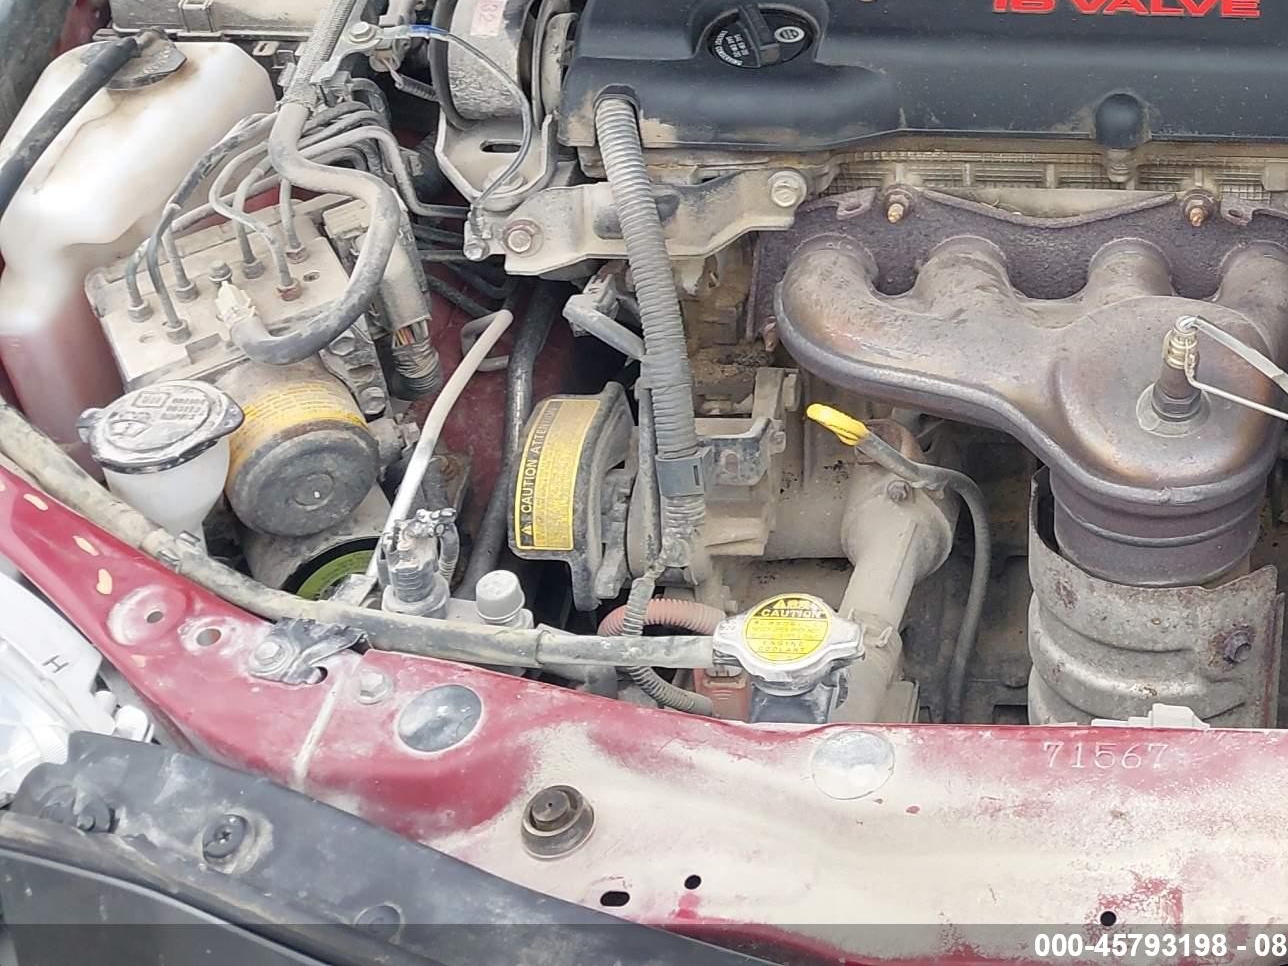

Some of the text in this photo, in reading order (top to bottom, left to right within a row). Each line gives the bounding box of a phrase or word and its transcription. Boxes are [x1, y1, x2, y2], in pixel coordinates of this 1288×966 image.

[521, 460, 538, 514] CAUTION
[761, 609, 822, 618] CAUTION
[1043, 741, 1169, 769] 71567
